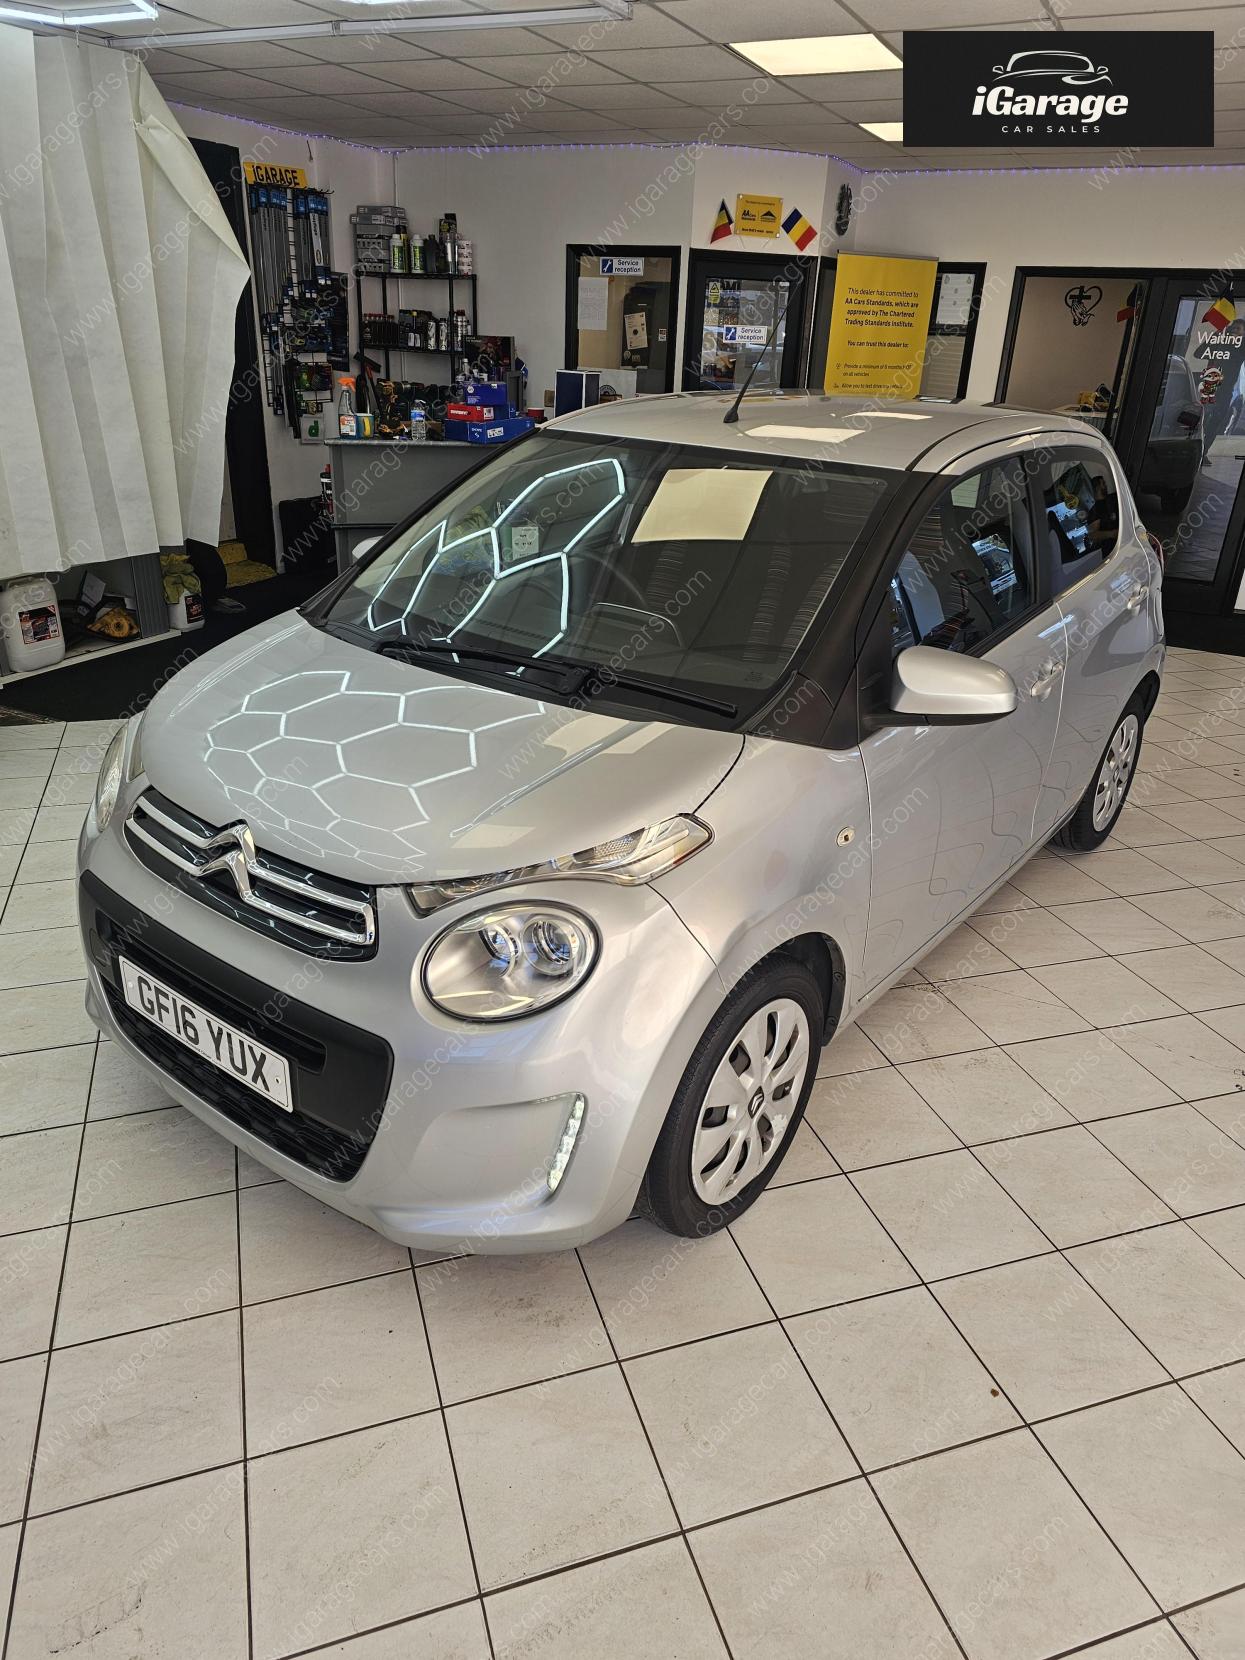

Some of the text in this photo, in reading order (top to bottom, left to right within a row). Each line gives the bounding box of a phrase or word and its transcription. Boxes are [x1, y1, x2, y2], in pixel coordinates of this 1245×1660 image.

[614, 267, 640, 275] reception
[845, 319, 864, 327] Trading
[1197, 331, 1243, 348] Waiting
[1200, 346, 1231, 360] Area
[137, 975, 270, 1093] GF16 YUX
